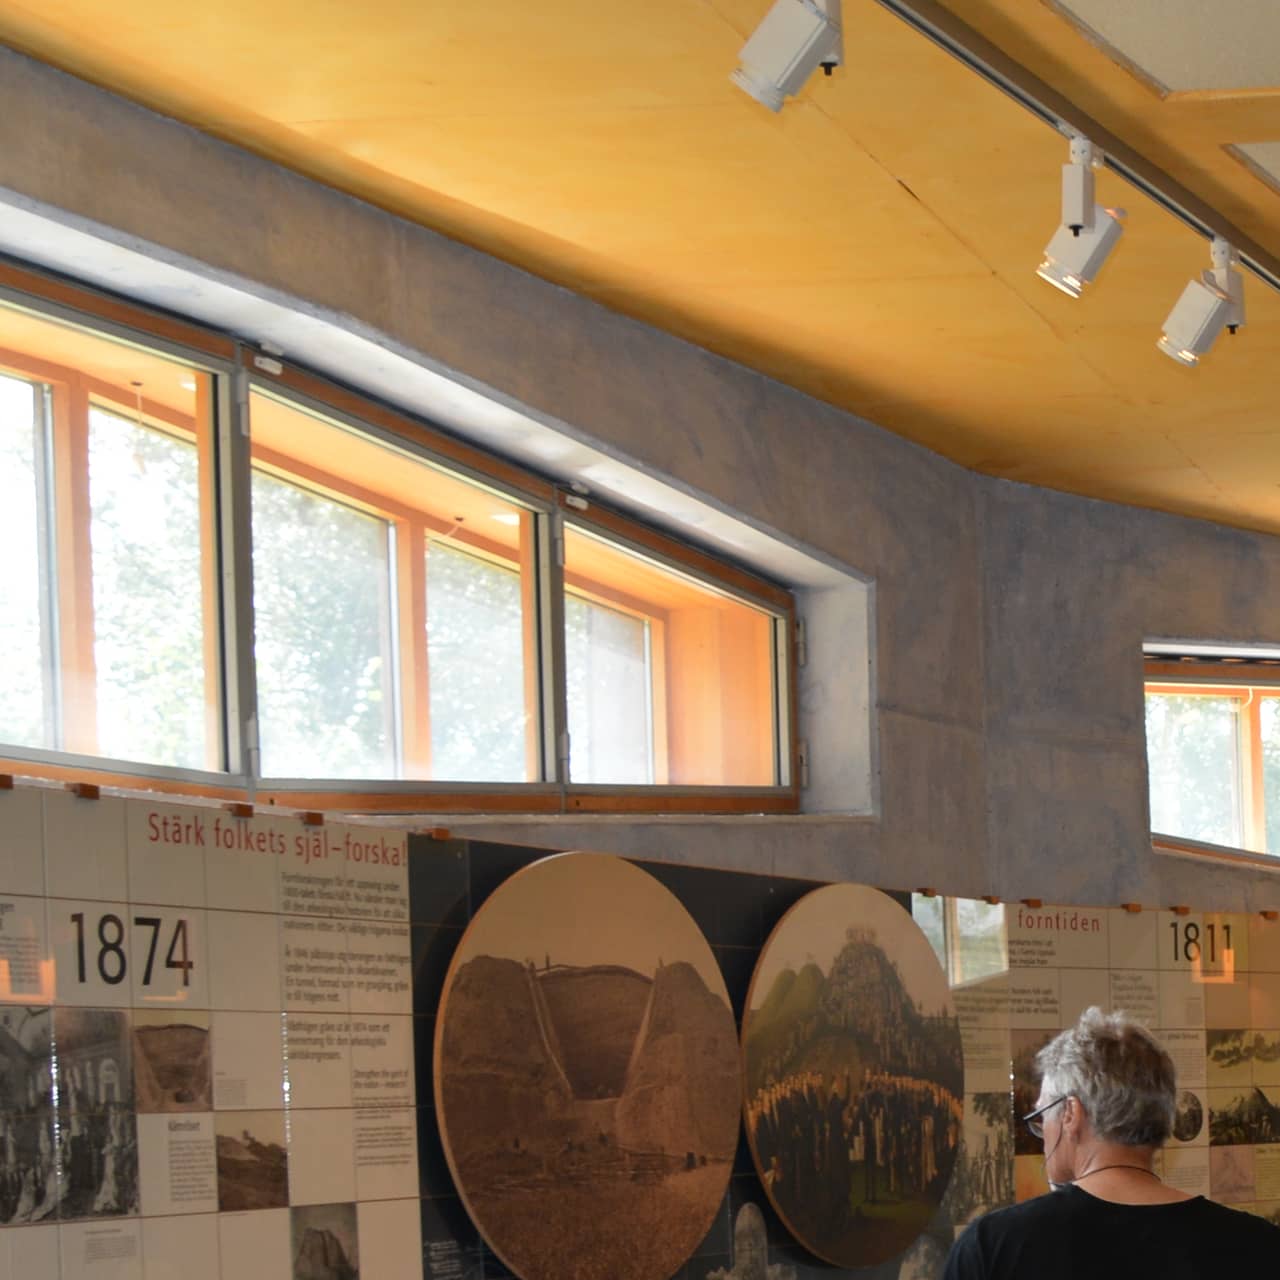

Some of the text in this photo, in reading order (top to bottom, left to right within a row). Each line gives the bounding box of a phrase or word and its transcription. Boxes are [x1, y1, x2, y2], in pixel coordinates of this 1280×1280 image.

[149, 813, 205, 847] Stärk
[214, 818, 287, 855] folkets
[1018, 909, 1100, 933] forntiden
[71, 912, 194, 987] 1874
[1170, 922, 1231, 963] 1811
